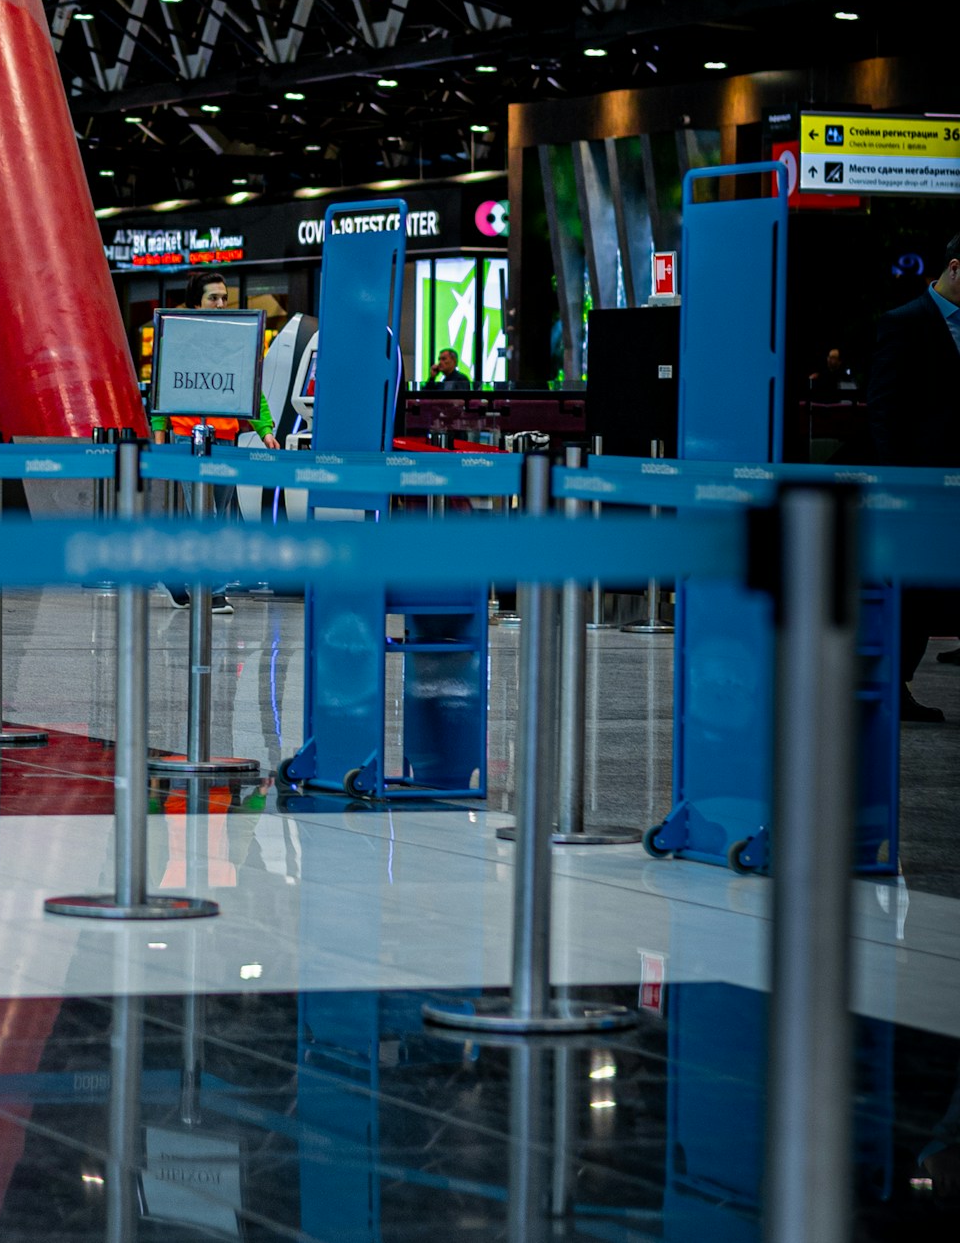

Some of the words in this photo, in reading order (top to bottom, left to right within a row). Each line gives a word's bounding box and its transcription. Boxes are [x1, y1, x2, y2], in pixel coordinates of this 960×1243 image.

[849, 127, 881, 137] Стойки
[883, 129, 938, 139] регистрации
[849, 163, 876, 174] Место
[877, 166, 904, 176] сдачи
[148, 229, 182, 253] market
[173, 371, 236, 394] ВЫХОД
